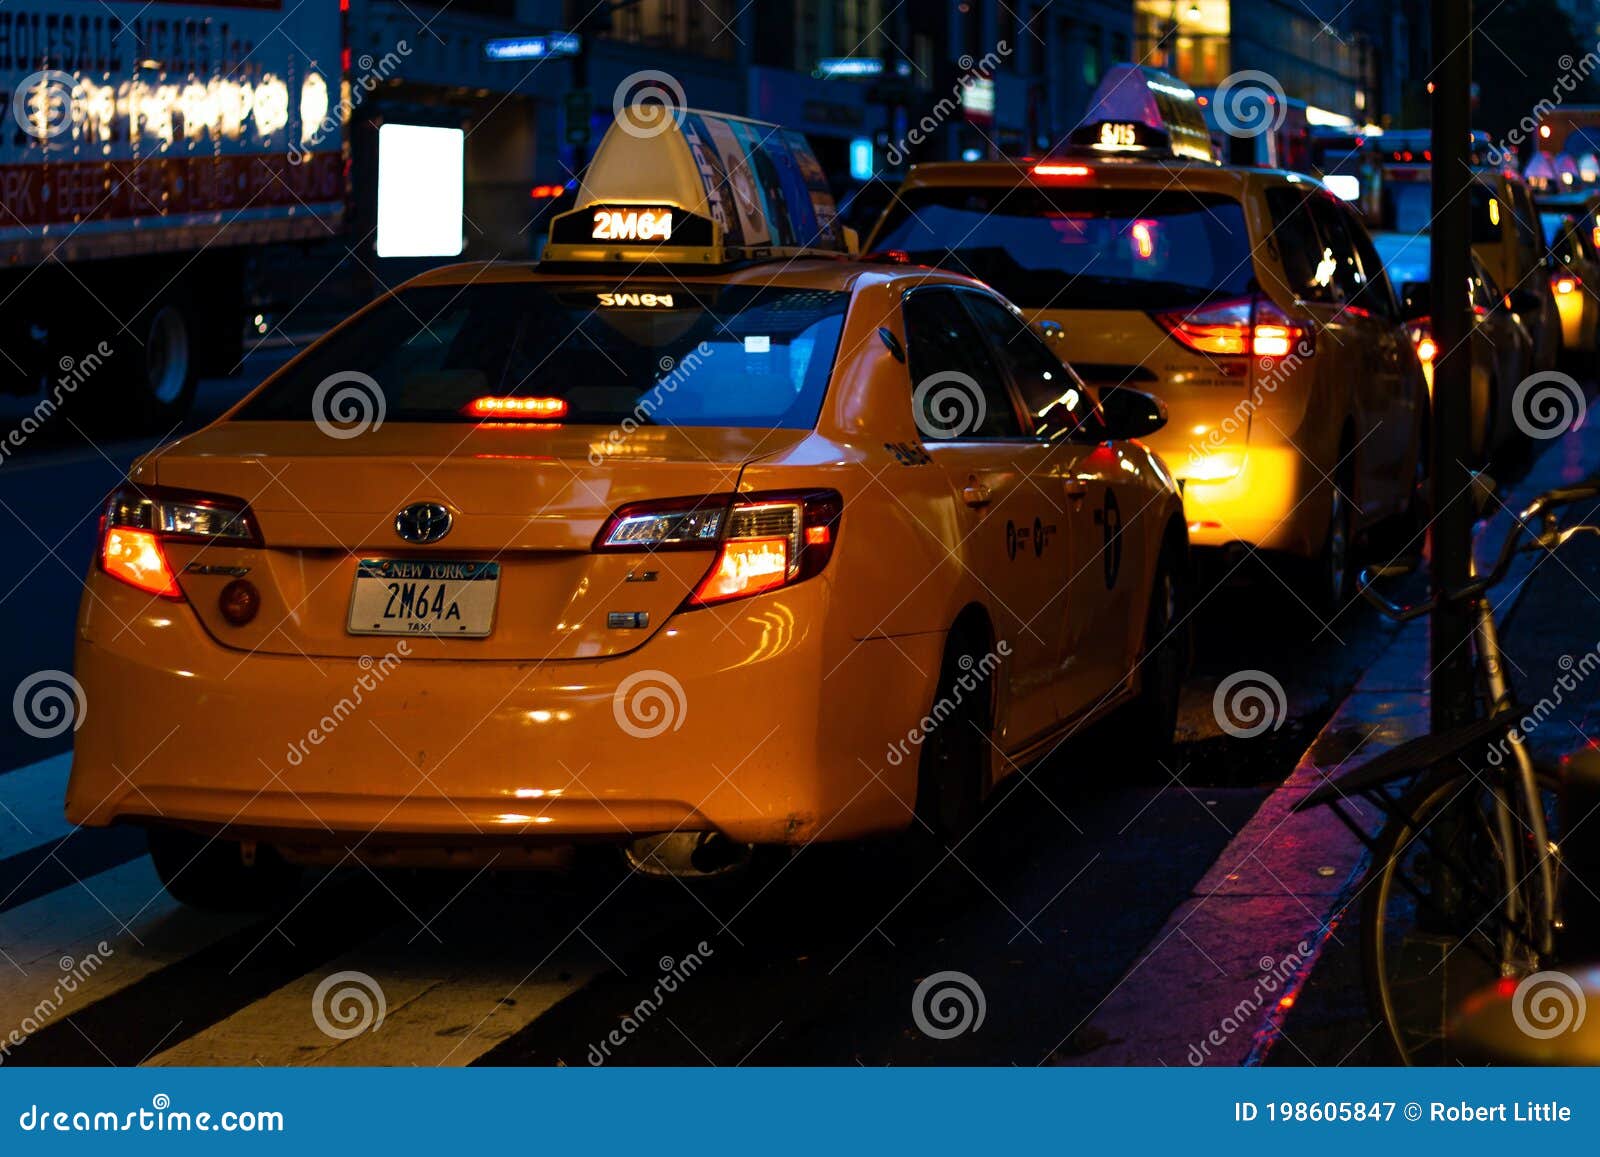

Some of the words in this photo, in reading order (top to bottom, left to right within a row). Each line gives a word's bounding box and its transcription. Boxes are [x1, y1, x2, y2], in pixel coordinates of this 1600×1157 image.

[592, 211, 673, 240] 2M64
[391, 564, 424, 578] NEW
[428, 564, 465, 579] YORK
[384, 582, 461, 621] 2M64A
